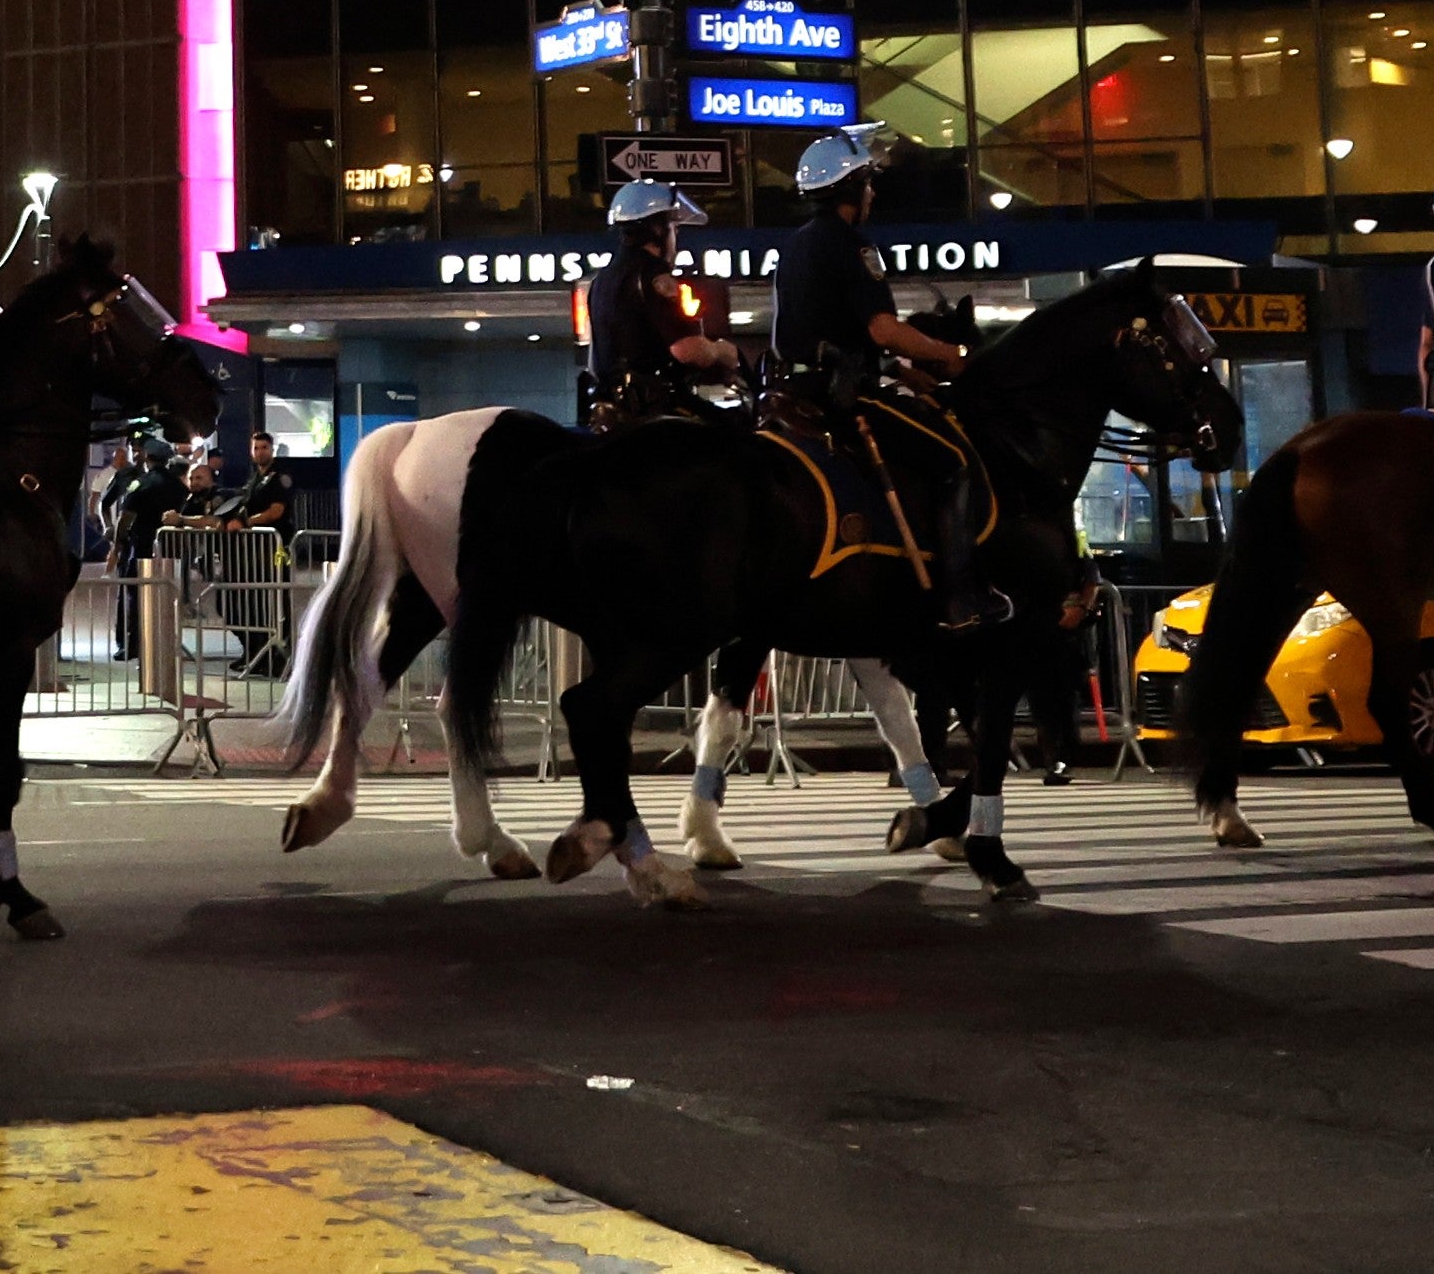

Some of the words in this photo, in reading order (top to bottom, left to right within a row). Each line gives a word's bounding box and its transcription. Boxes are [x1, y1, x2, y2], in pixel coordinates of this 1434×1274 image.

[604, 20, 624, 50] St
[698, 14, 783, 51] Eighth
[789, 19, 842, 49] Ave
[701, 86, 741, 116] Joe
[745, 88, 806, 119] Louis
[810, 98, 845, 117] Plaza
[624, 152, 659, 171] ONE
[674, 152, 713, 171] WAY
[441, 248, 781, 284] PENNSYANIA
[1192, 294, 1256, 328] AXI
